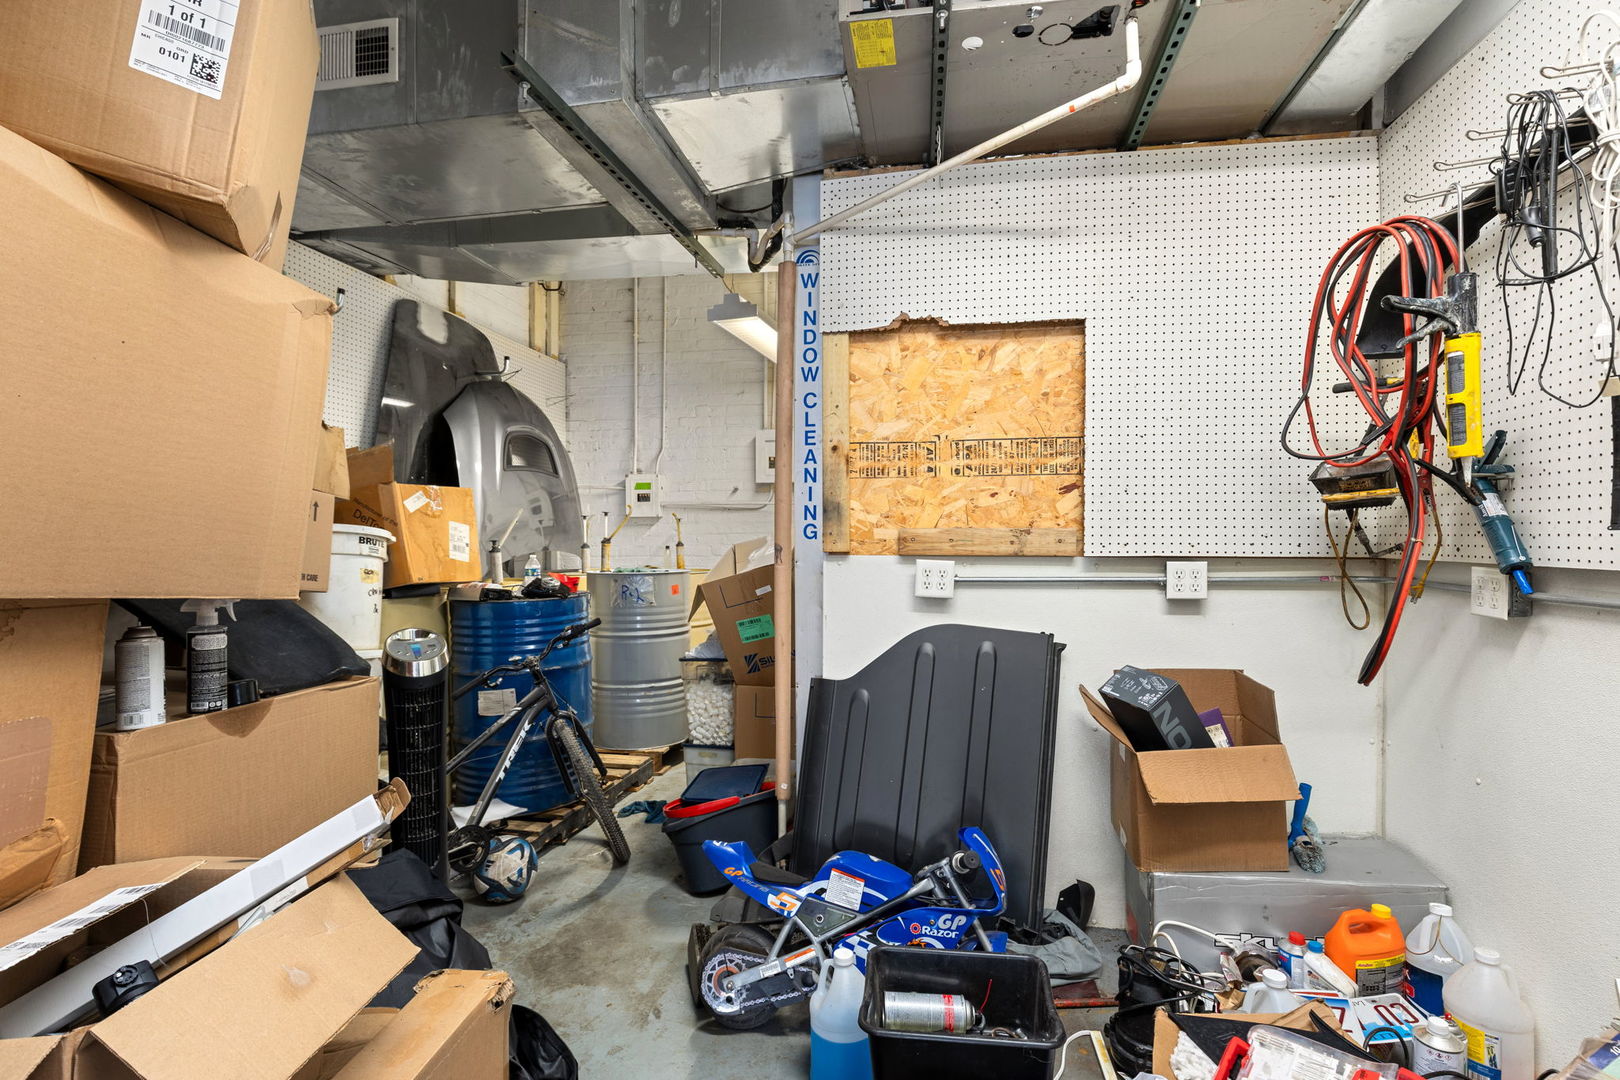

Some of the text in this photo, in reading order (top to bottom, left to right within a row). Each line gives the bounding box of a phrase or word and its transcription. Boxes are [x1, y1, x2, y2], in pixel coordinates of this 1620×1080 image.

[168, 4, 206, 29] 1 of 1
[159, 46, 185, 63] 0101
[800, 272, 820, 383] WINDOW
[803, 392, 818, 540] CLEANING
[358, 536, 385, 549] BRUTE
[495, 719, 532, 782] TREK
[723, 867, 743, 876] GP
[769, 892, 798, 911] 5
[938, 913, 967, 930] GP
[921, 925, 960, 939] Razor
